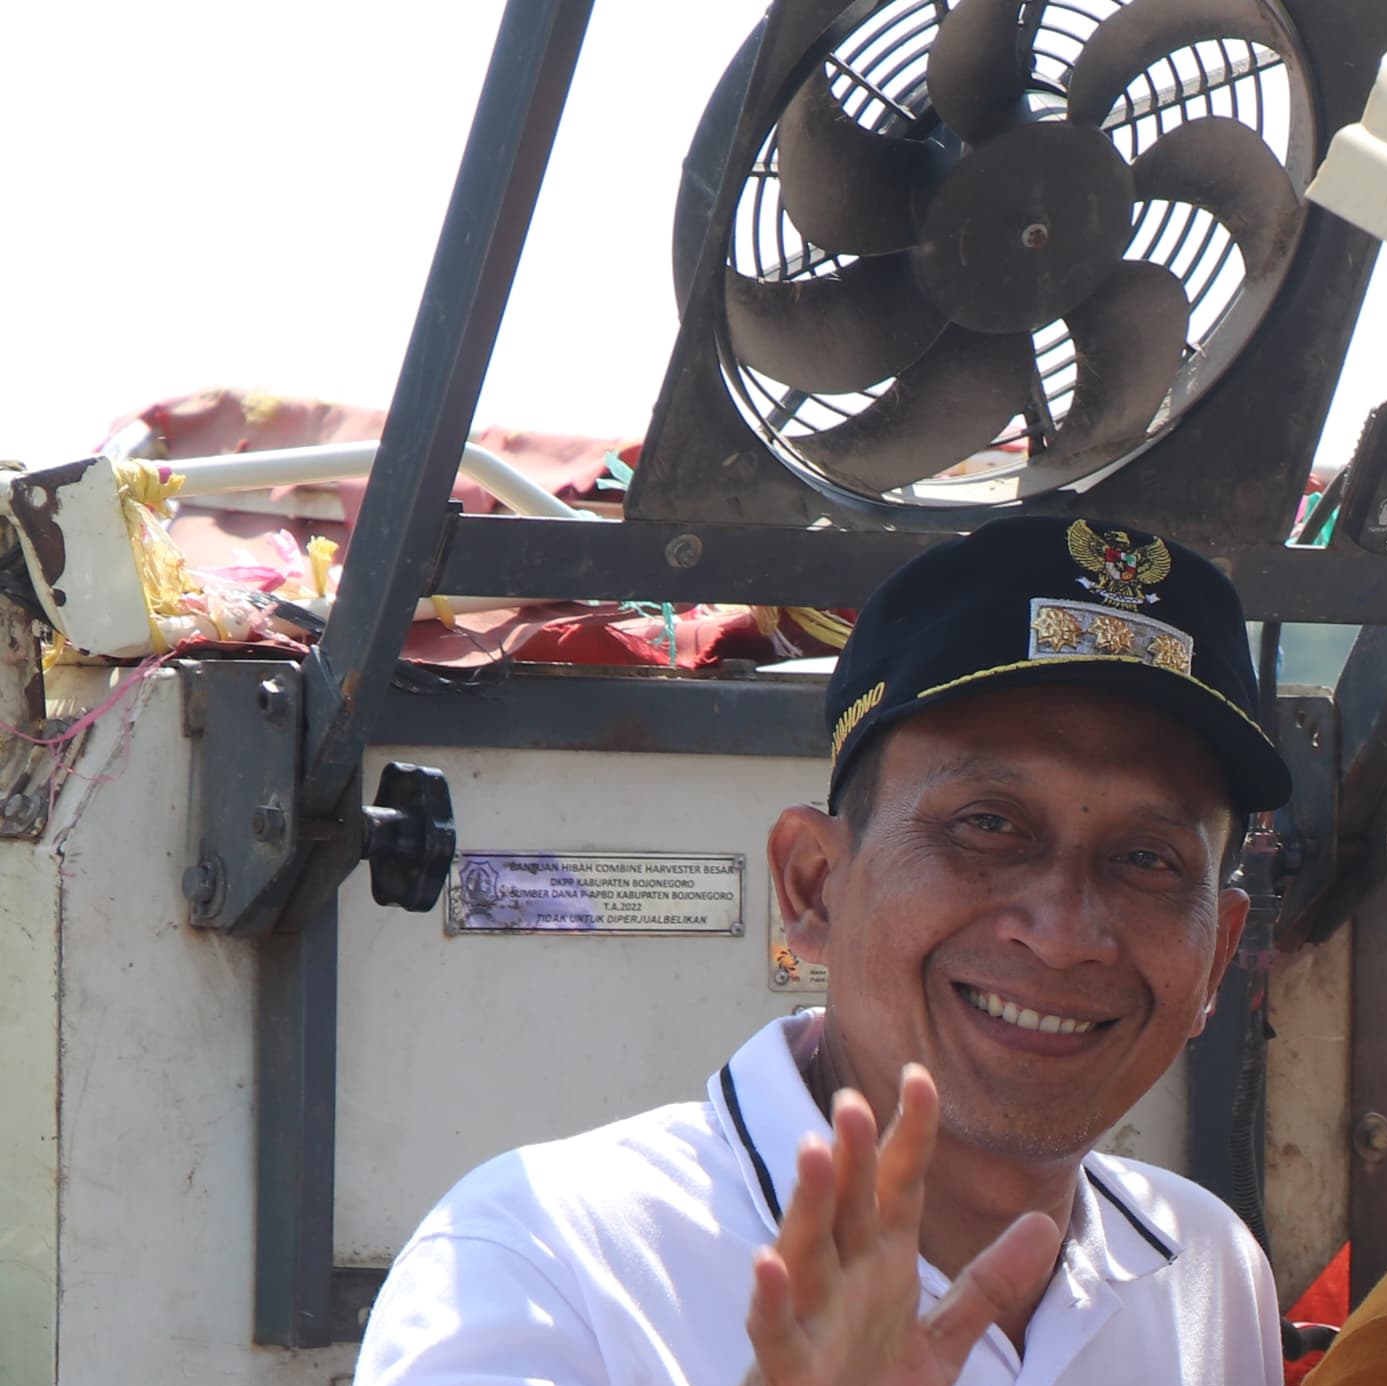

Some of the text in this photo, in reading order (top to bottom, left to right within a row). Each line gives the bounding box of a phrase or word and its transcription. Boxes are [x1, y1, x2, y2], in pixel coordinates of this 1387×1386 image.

[561, 863, 593, 873] HIBAH
[595, 864, 643, 873] COMBINE
[645, 864, 701, 874] HARVESTER
[703, 865, 735, 875] BESAR
[550, 878, 695, 889] DKPP KABUPATEN BOJONEGORO
[511, 889, 549, 898] SUMBER
[551, 890, 579, 898] DANA
[616, 891, 670, 900] KABUPATEN
[671, 892, 734, 901] BOJONEGORO
[536, 913, 708, 924] TIDAK UNTUK DIPERJUALBELIKAN
